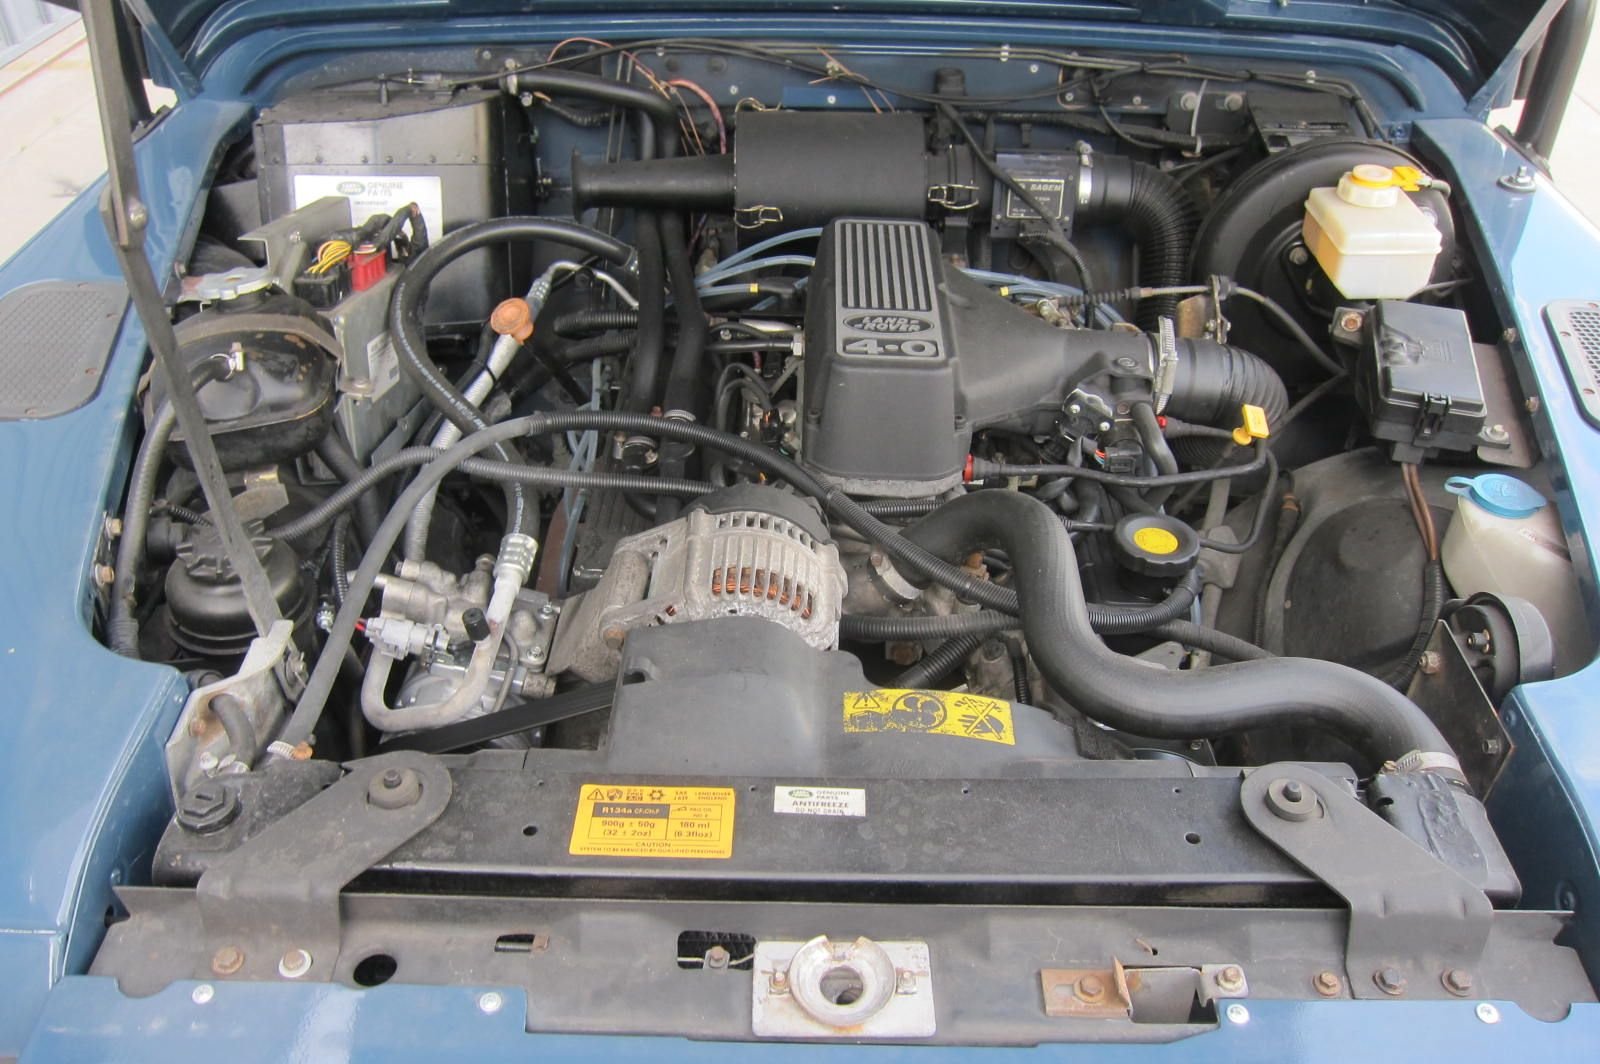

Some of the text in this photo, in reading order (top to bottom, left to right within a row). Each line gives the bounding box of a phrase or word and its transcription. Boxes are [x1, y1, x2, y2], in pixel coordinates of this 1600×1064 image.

[792, 800, 848, 808] ANTIFREEZE
[602, 806, 632, 814] R134a
[602, 820, 624, 828] 900g
[638, 821, 655, 829] 50g
[603, 828, 617, 836] (32
[632, 829, 651, 837] 2oz)
